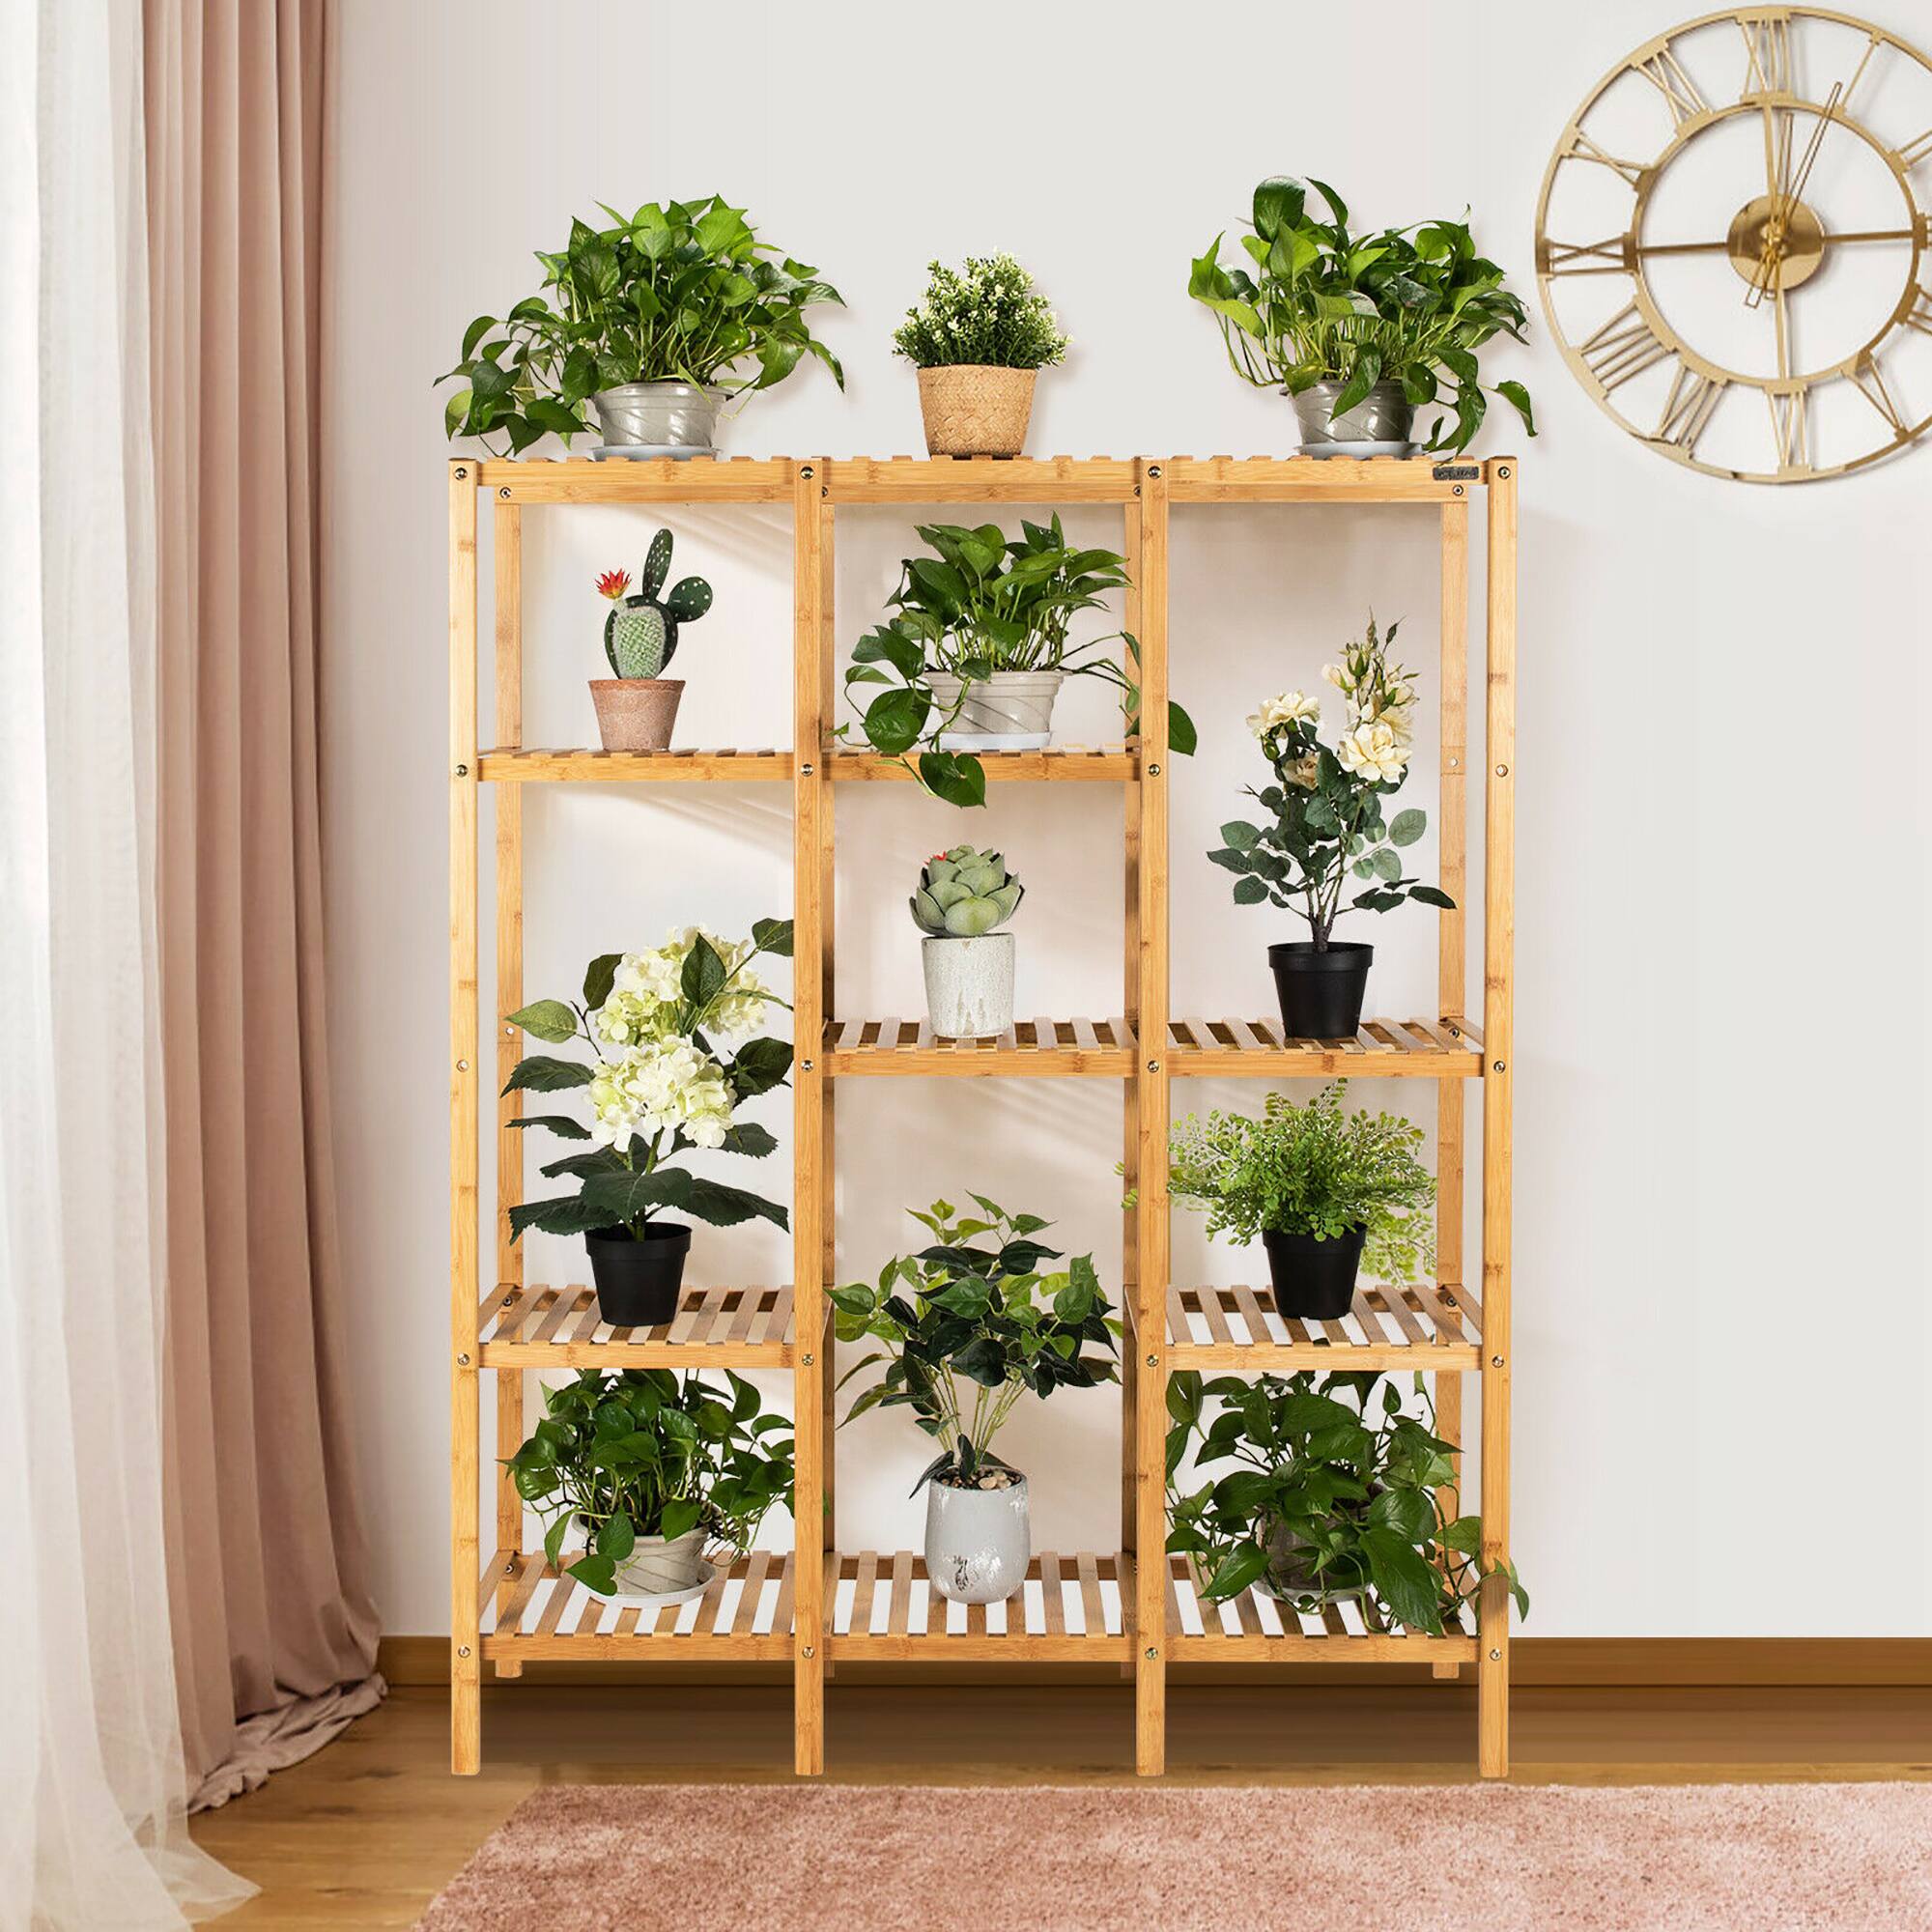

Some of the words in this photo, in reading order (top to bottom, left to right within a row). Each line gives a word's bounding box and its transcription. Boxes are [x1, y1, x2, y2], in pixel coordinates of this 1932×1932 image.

[1630, 39, 1713, 139] XI
[1736, 11, 1794, 100] XII
[1562, 130, 1660, 191] X
[1536, 233, 1639, 278] IX
[1569, 295, 1678, 398] VIII
[1649, 357, 1728, 458] VII
[1765, 381, 1811, 473] VI
[1840, 348, 1911, 442] V
